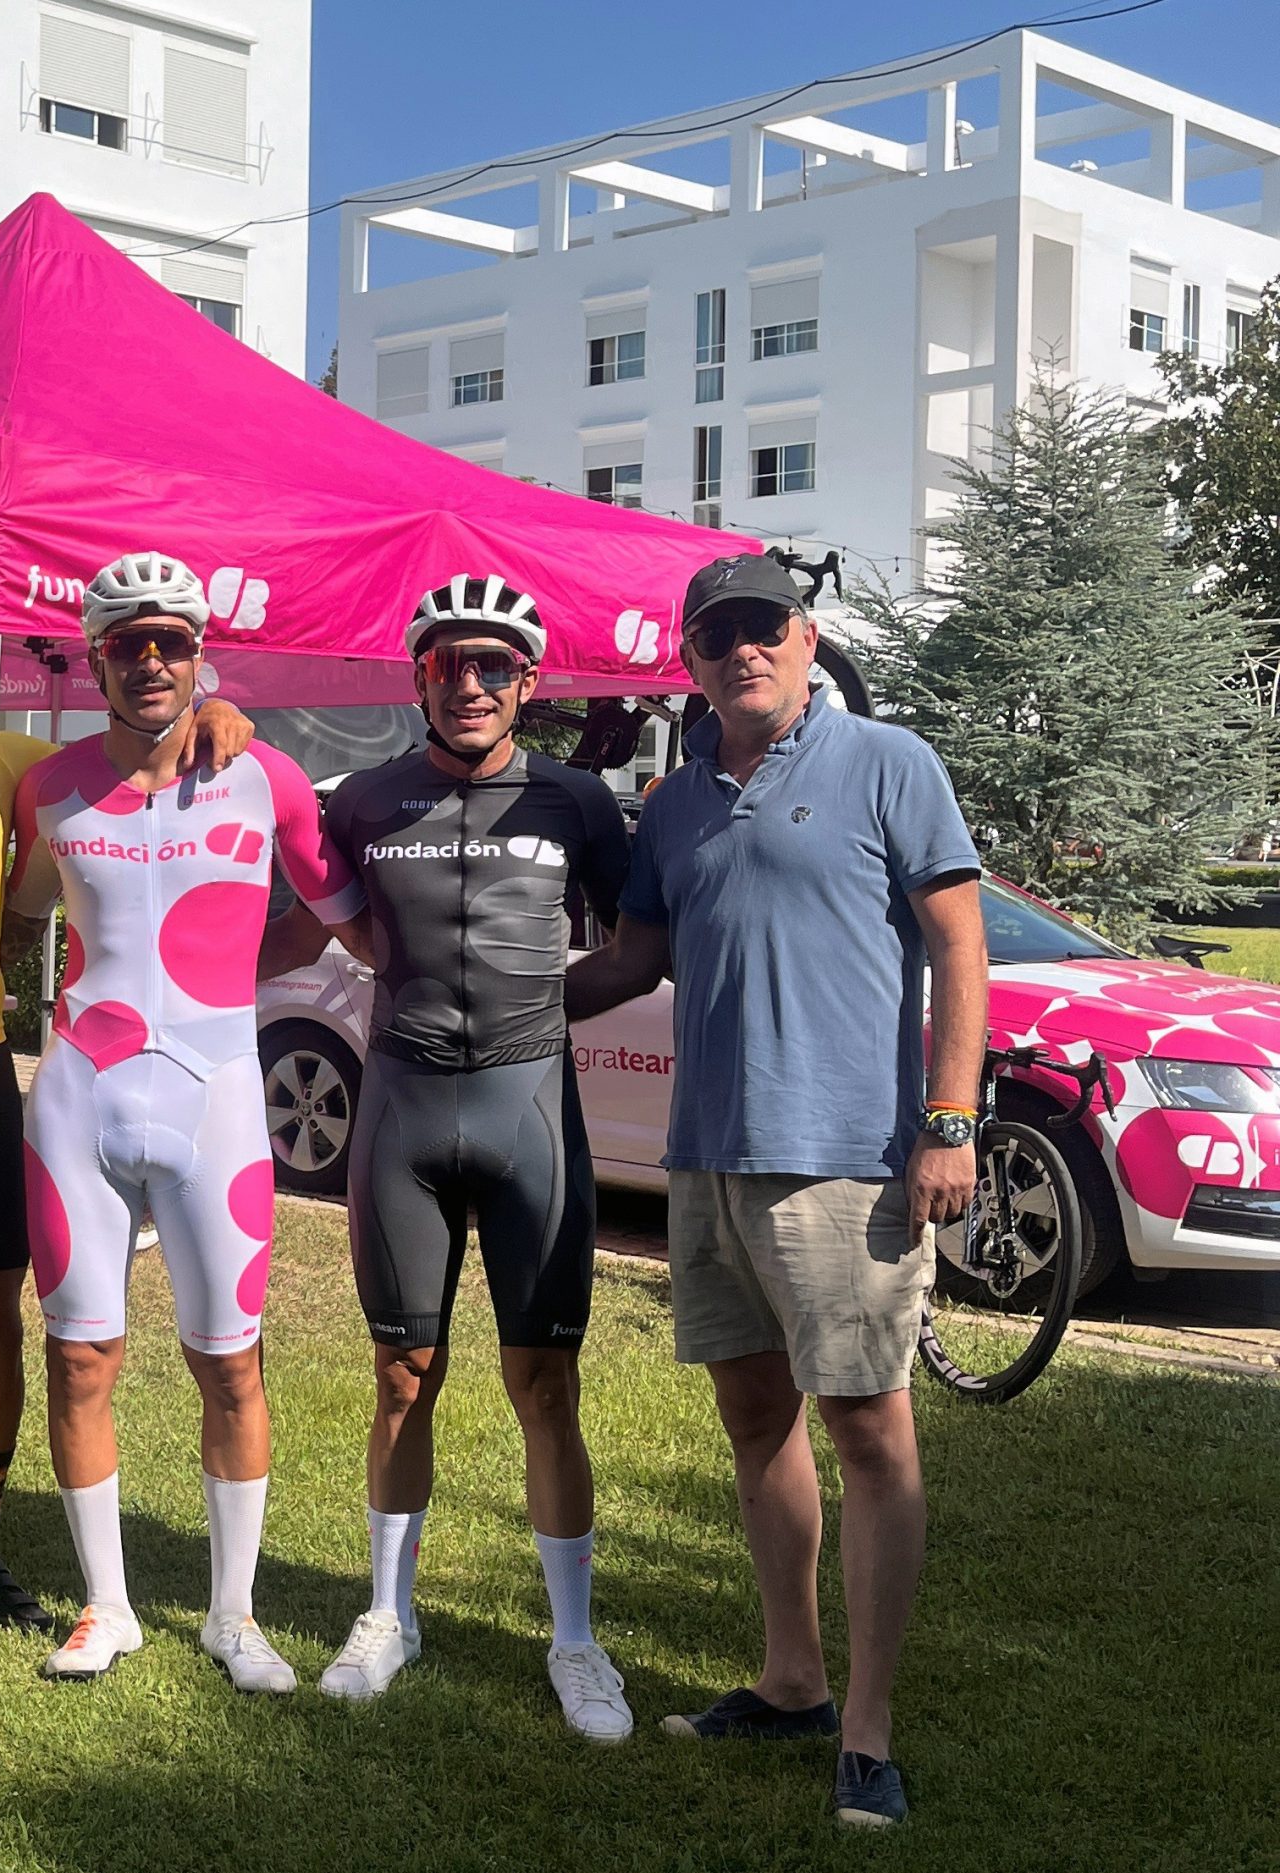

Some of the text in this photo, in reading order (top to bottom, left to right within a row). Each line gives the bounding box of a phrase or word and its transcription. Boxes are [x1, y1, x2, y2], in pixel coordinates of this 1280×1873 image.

[23, 565, 84, 608] fun
[183, 786, 231, 806] GOBIK
[401, 800, 439, 809] GOBIK
[49, 836, 197, 864] fundación
[363, 839, 501, 865] fundación
